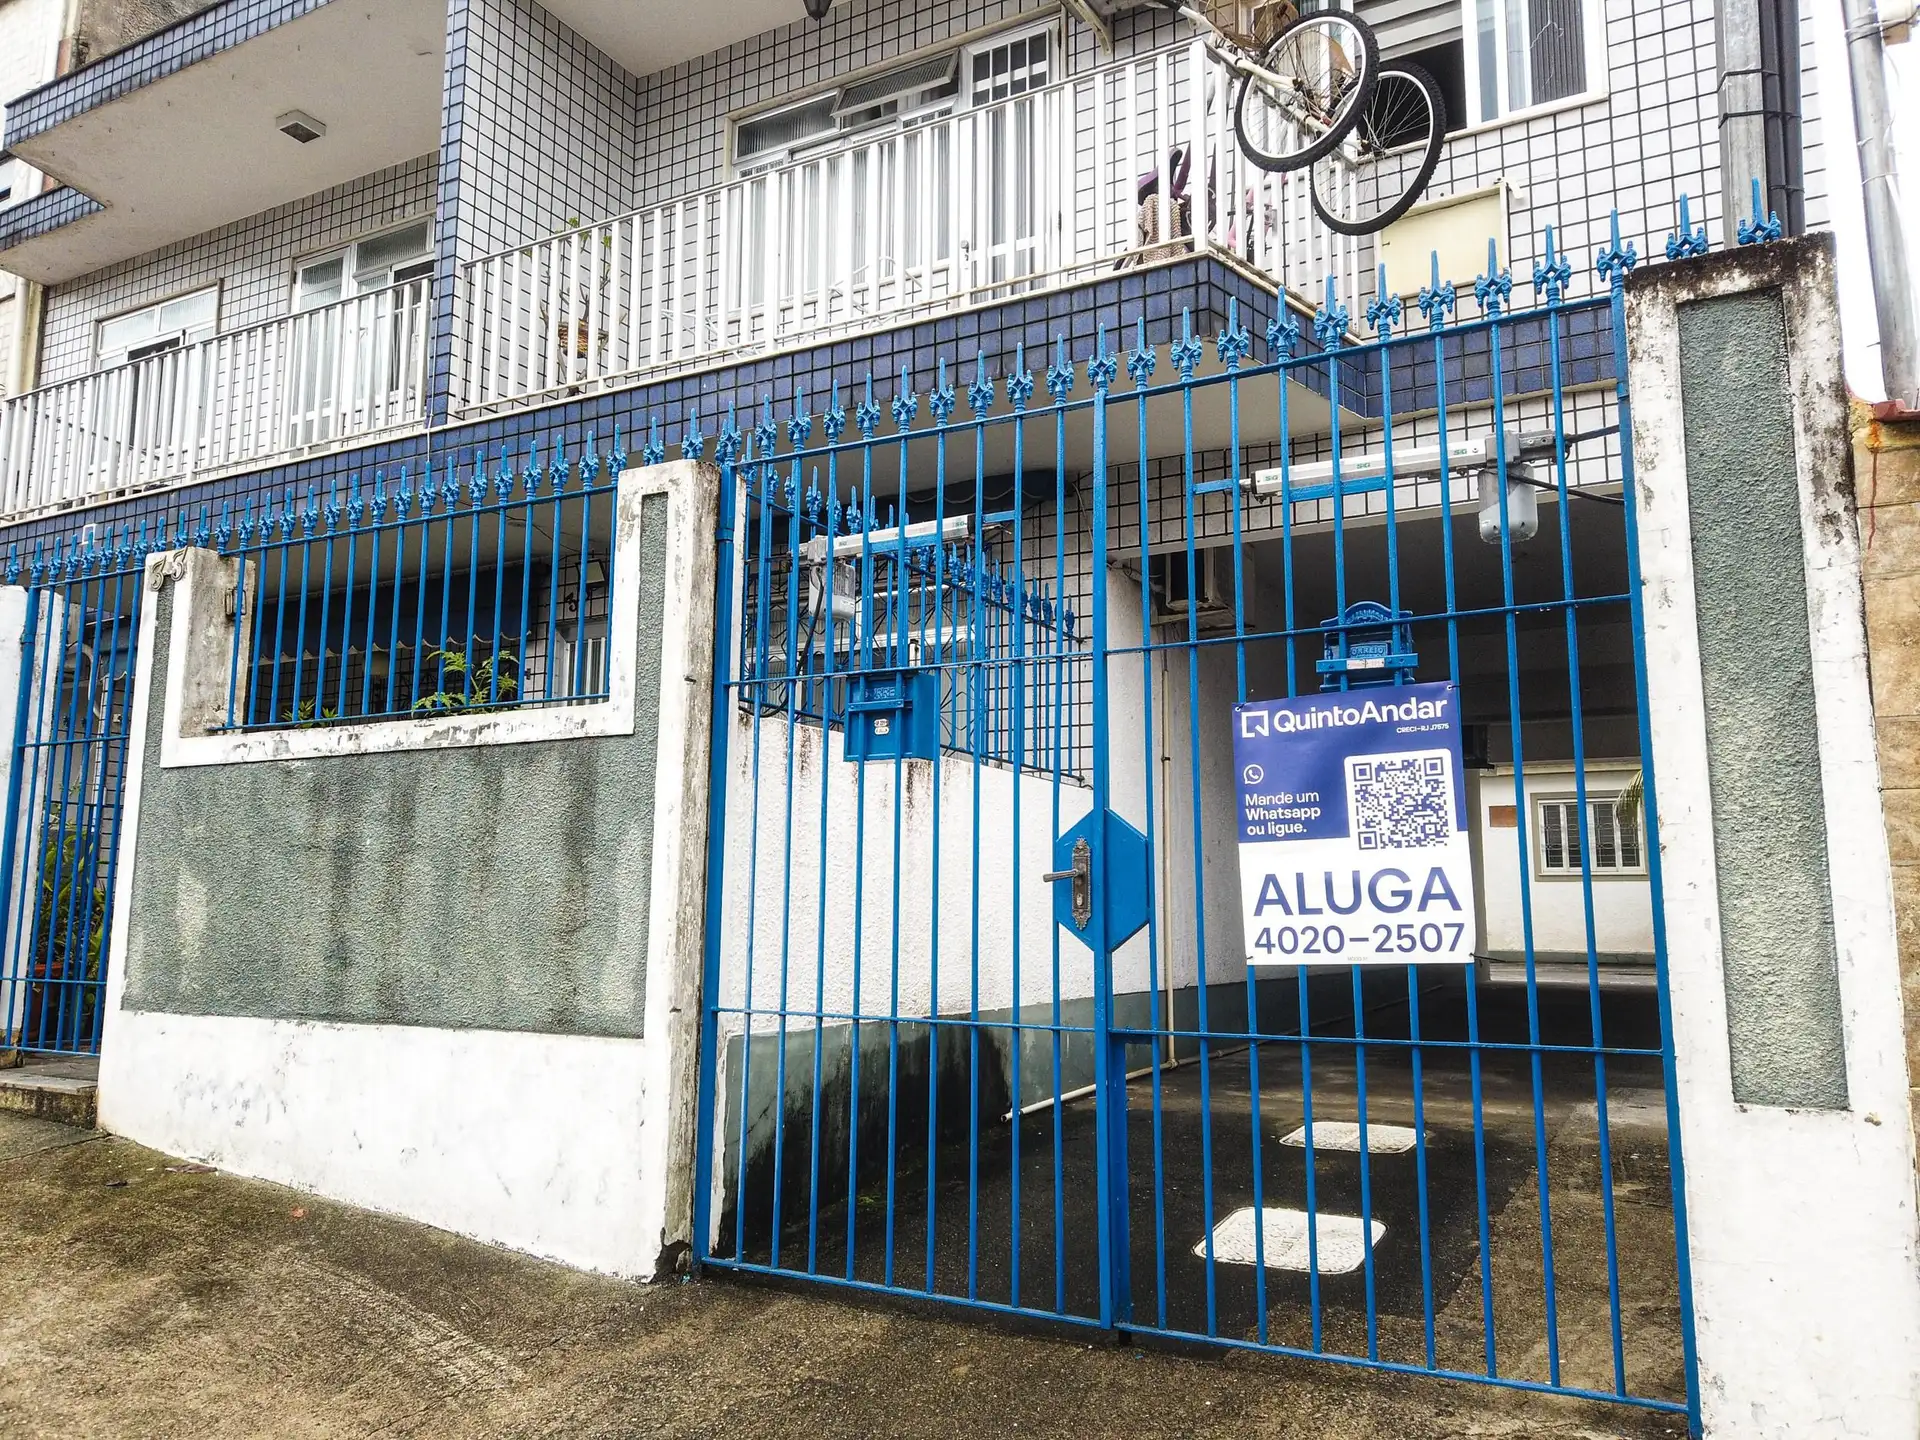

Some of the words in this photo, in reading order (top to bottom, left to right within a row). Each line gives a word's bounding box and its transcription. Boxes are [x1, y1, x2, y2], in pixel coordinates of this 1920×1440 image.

[1273, 697, 1448, 733] QuintoAndar
[1245, 792, 1294, 806] Mande
[1296, 791, 1320, 803] um
[1247, 805, 1321, 821] Whatsapp
[1247, 823, 1265, 836] ou
[1267, 820, 1308, 837] ligue.
[1253, 867, 1463, 917] ALUGA
[1254, 923, 1465, 954] 4020-2507
